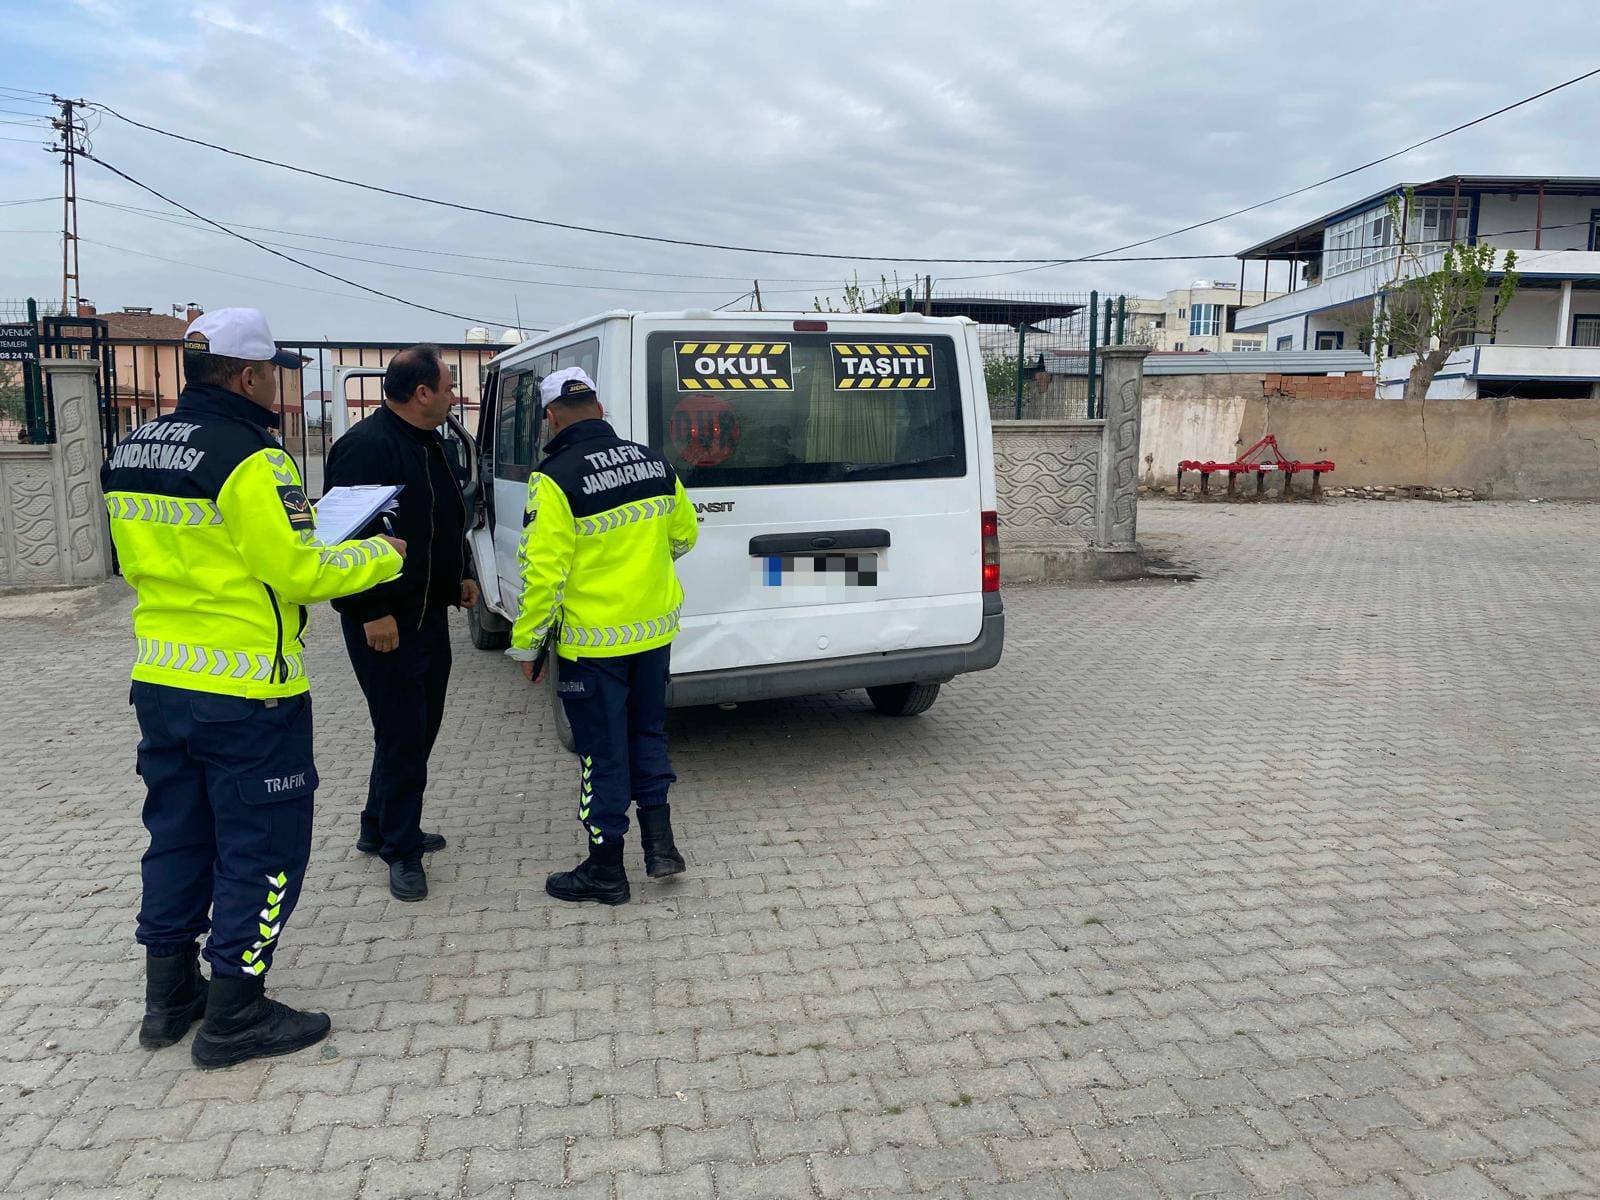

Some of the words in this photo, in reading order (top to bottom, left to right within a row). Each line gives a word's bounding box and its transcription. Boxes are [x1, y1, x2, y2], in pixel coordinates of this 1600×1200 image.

[11, 352, 22, 360] 24
[694, 357, 777, 375] OKUL
[841, 357, 925, 377] TAŞITI
[109, 443, 205, 472] JANDARMASI
[582, 461, 667, 495] JANDARMASI
[692, 501, 736, 513] NSIT
